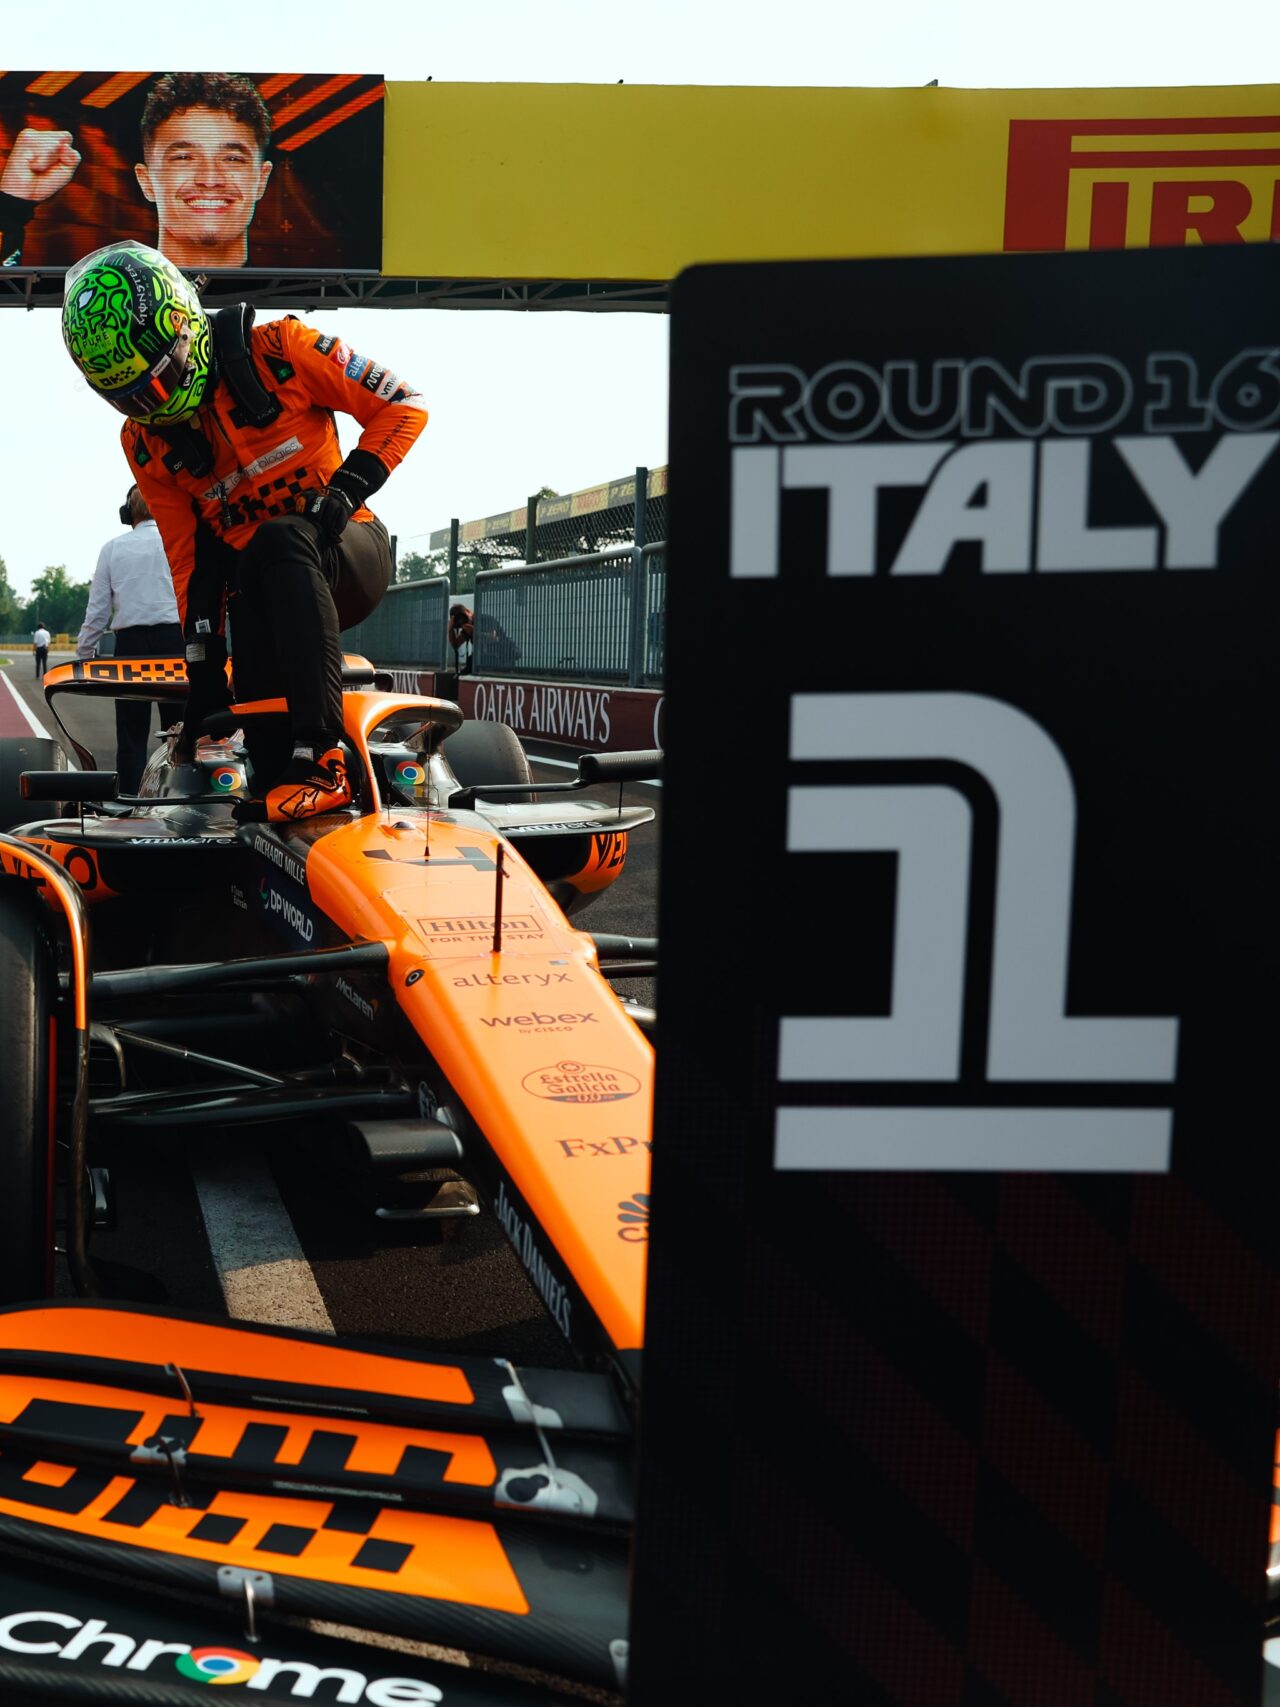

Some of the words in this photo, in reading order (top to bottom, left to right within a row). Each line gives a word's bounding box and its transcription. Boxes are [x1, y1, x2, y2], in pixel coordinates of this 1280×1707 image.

[729, 353, 1134, 443] ROUND
[1144, 346, 1280, 434] 16
[730, 432, 1280, 579] ITALY
[474, 683, 525, 730] QATAR
[529, 687, 611, 744] AIRWAYS
[508, 821, 603, 832] vmware
[128, 837, 235, 847] vmware
[254, 835, 284, 868] RICHARD
[284, 855, 306, 886] MILLE
[270, 889, 282, 913] DP
[282, 898, 314, 942] WORLD
[430, 918, 529, 933] Hilton
[774, 691, 1180, 1173] 1
[507, 933, 545, 941] STAY
[453, 971, 574, 988] alteryx
[335, 976, 374, 1021] McLaren
[479, 1011, 600, 1028] webex
[539, 1072, 619, 1084] Estrella
[546, 1082, 621, 1094] Galicia
